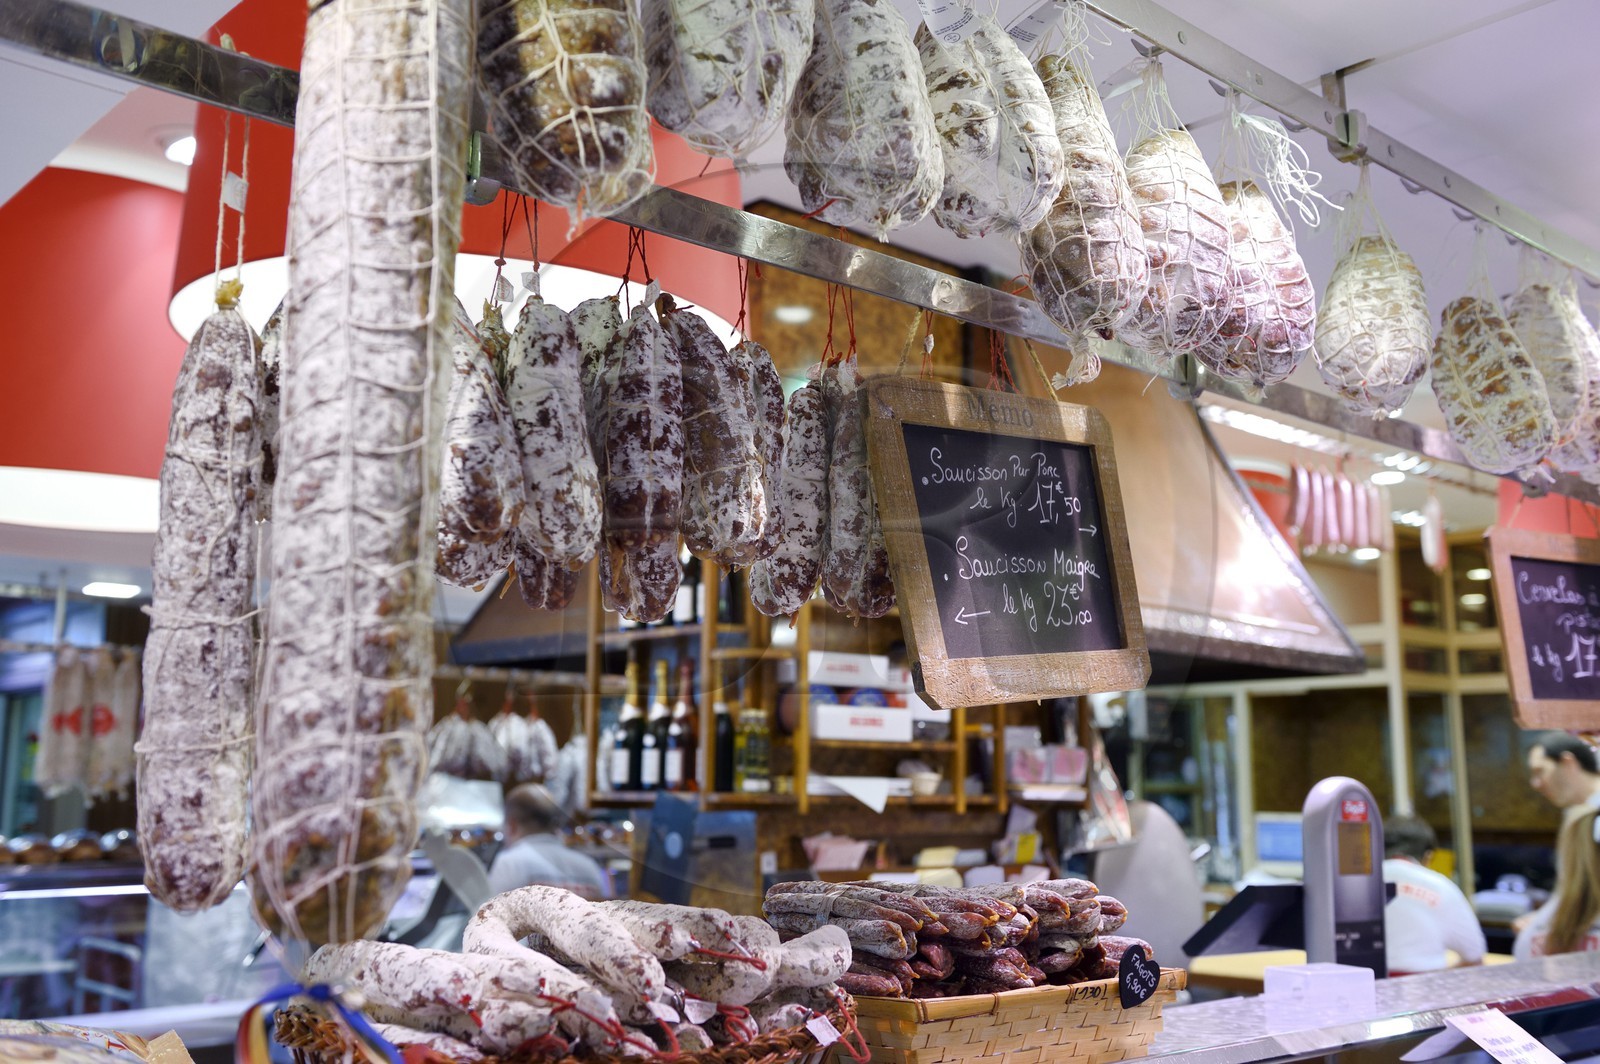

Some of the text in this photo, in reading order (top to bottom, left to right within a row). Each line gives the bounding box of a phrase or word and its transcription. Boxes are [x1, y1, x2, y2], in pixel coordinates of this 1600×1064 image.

[967, 395, 1034, 428] Memo
[930, 447, 1008, 484] Saucisson
[1009, 455, 1031, 478] Pur
[970, 487, 992, 509] le
[955, 536, 1047, 580] Saucisson
[1003, 583, 1019, 614] le
[1125, 972, 1147, 999] 6,90€
[1131, 953, 1157, 988] FAGOTS
